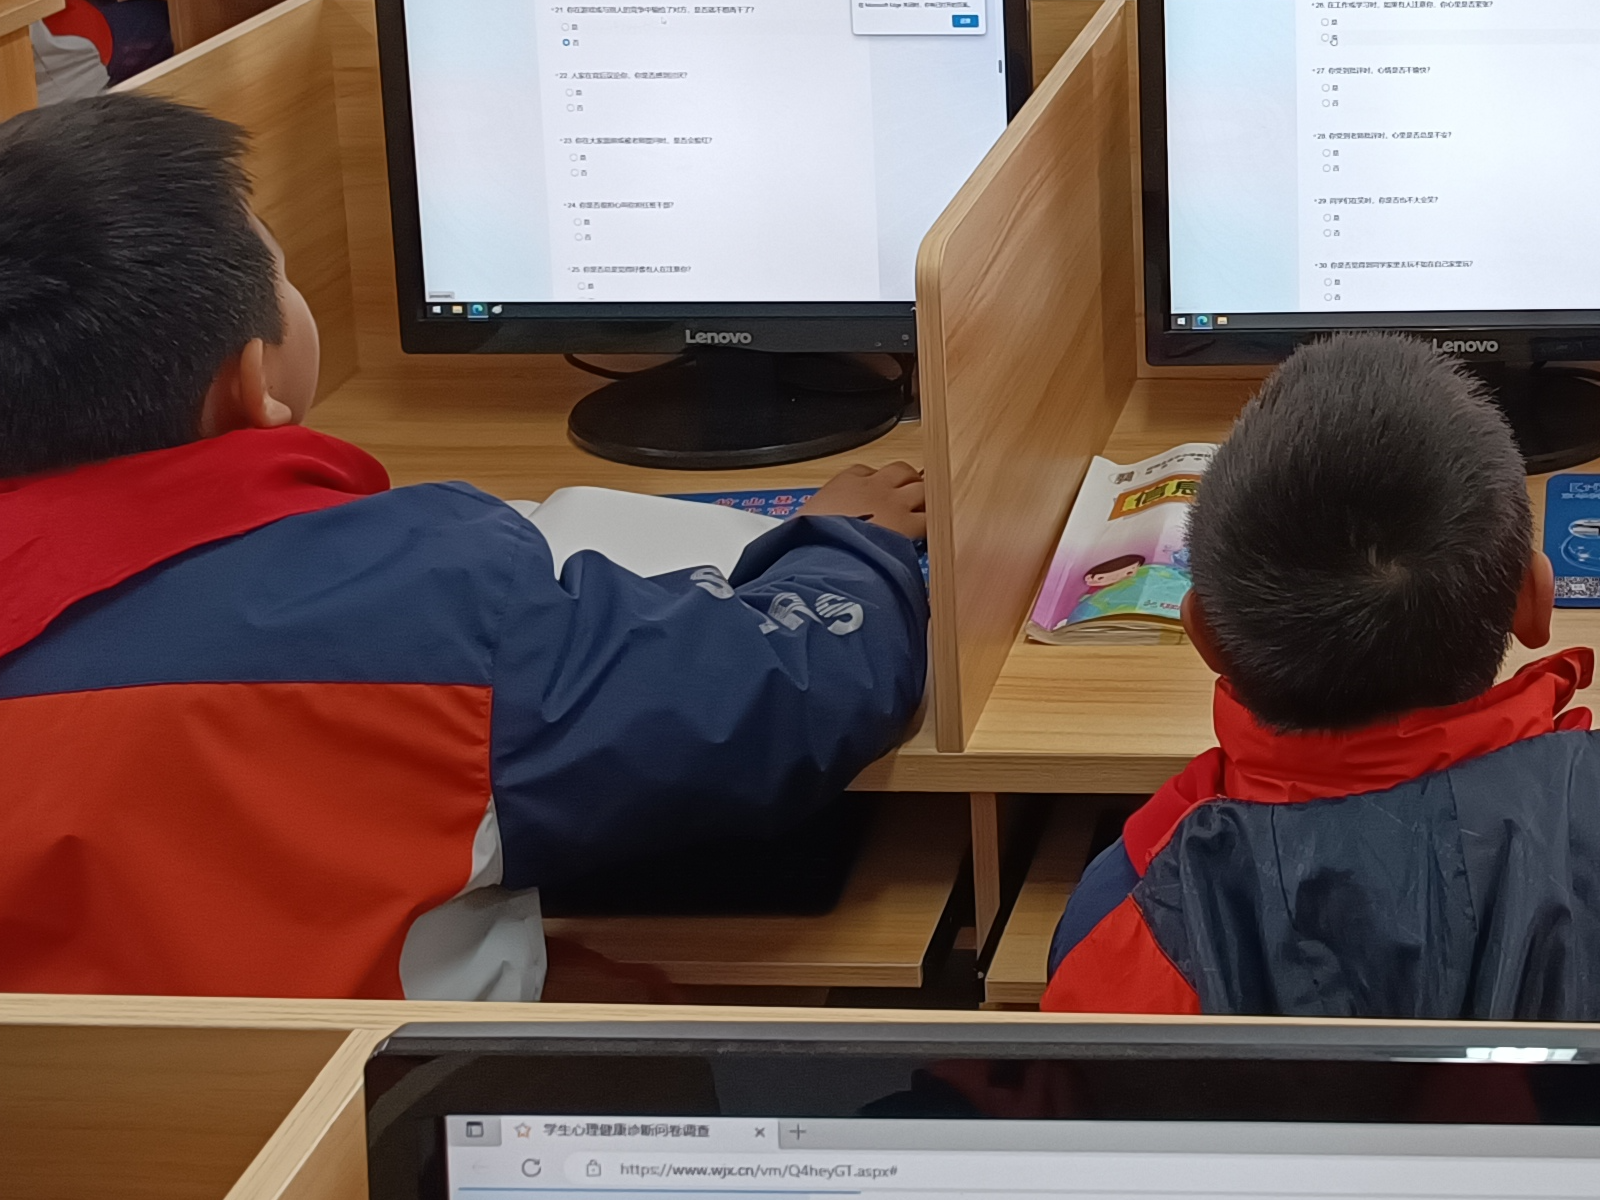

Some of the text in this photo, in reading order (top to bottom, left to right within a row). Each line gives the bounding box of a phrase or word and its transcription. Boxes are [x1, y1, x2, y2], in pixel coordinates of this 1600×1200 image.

[684, 329, 753, 344] Lenovo
[1432, 337, 1499, 354] Lenovo
[543, 1123, 710, 1139] 学生心理健康诊断问卷调查
[620, 1161, 898, 1180] https://www.wjx.cn/vm/Q4heyGT.aspx#
